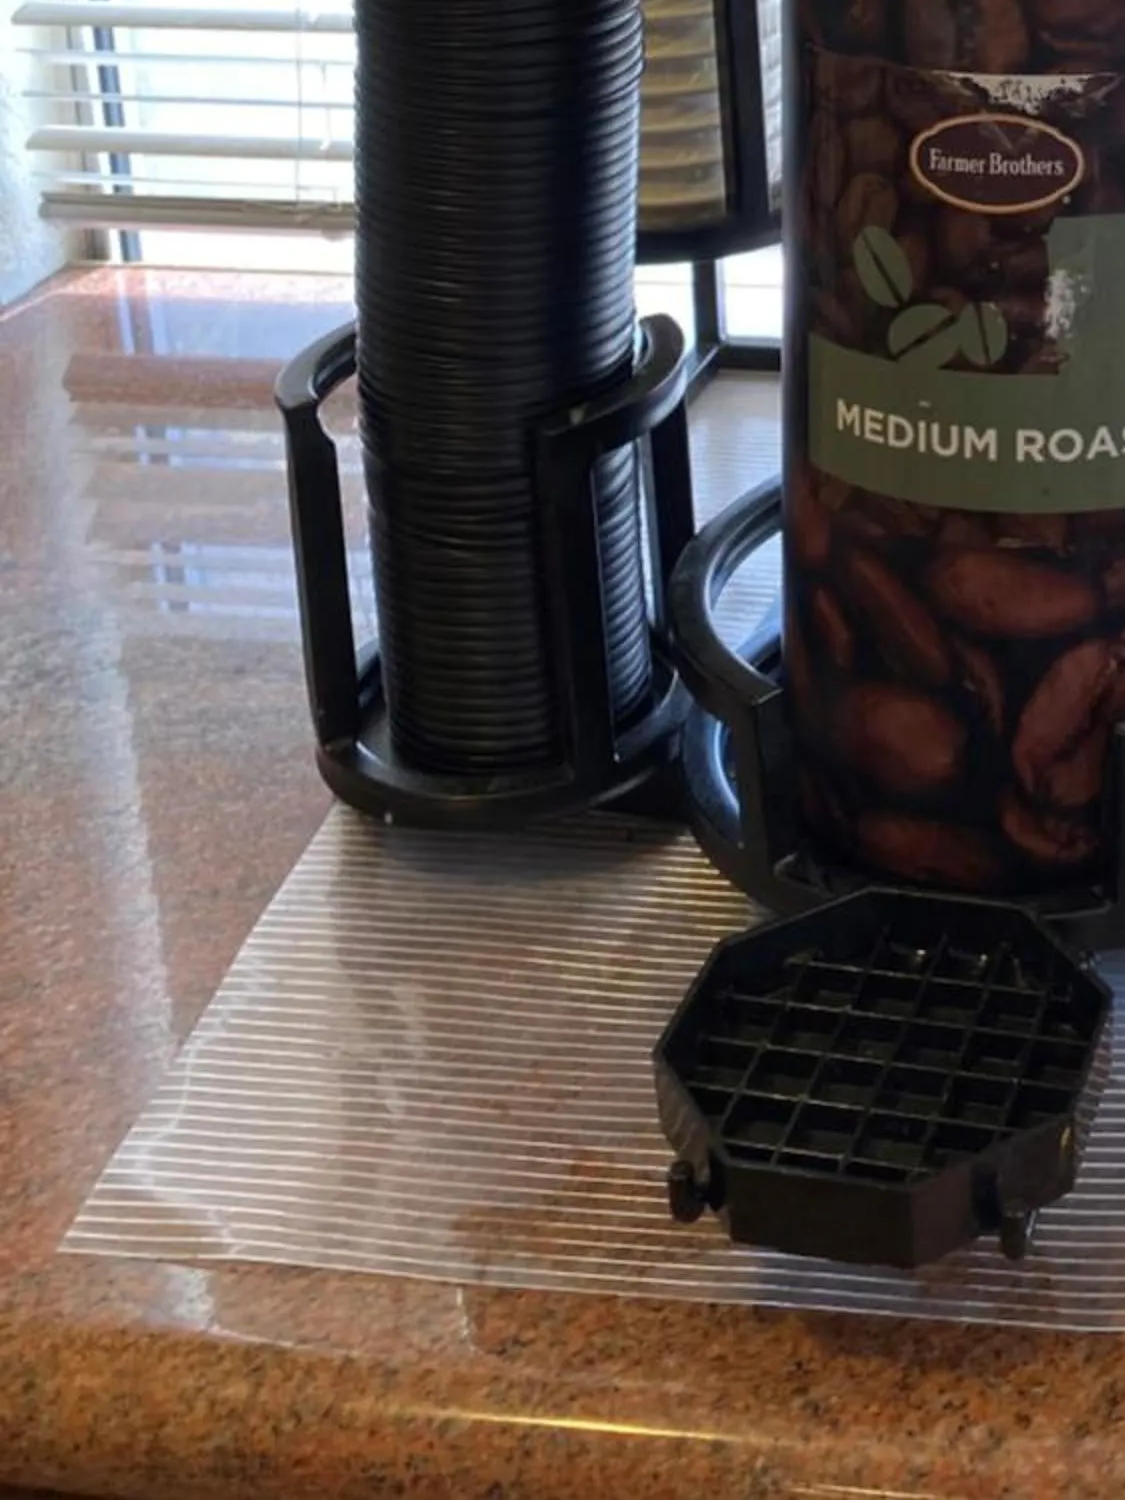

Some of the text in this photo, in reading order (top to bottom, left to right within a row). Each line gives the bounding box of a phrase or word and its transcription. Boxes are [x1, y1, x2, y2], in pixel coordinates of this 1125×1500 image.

[928, 148, 1065, 176] Farmer Brothers
[836, 399, 998, 463] MEDIUM
